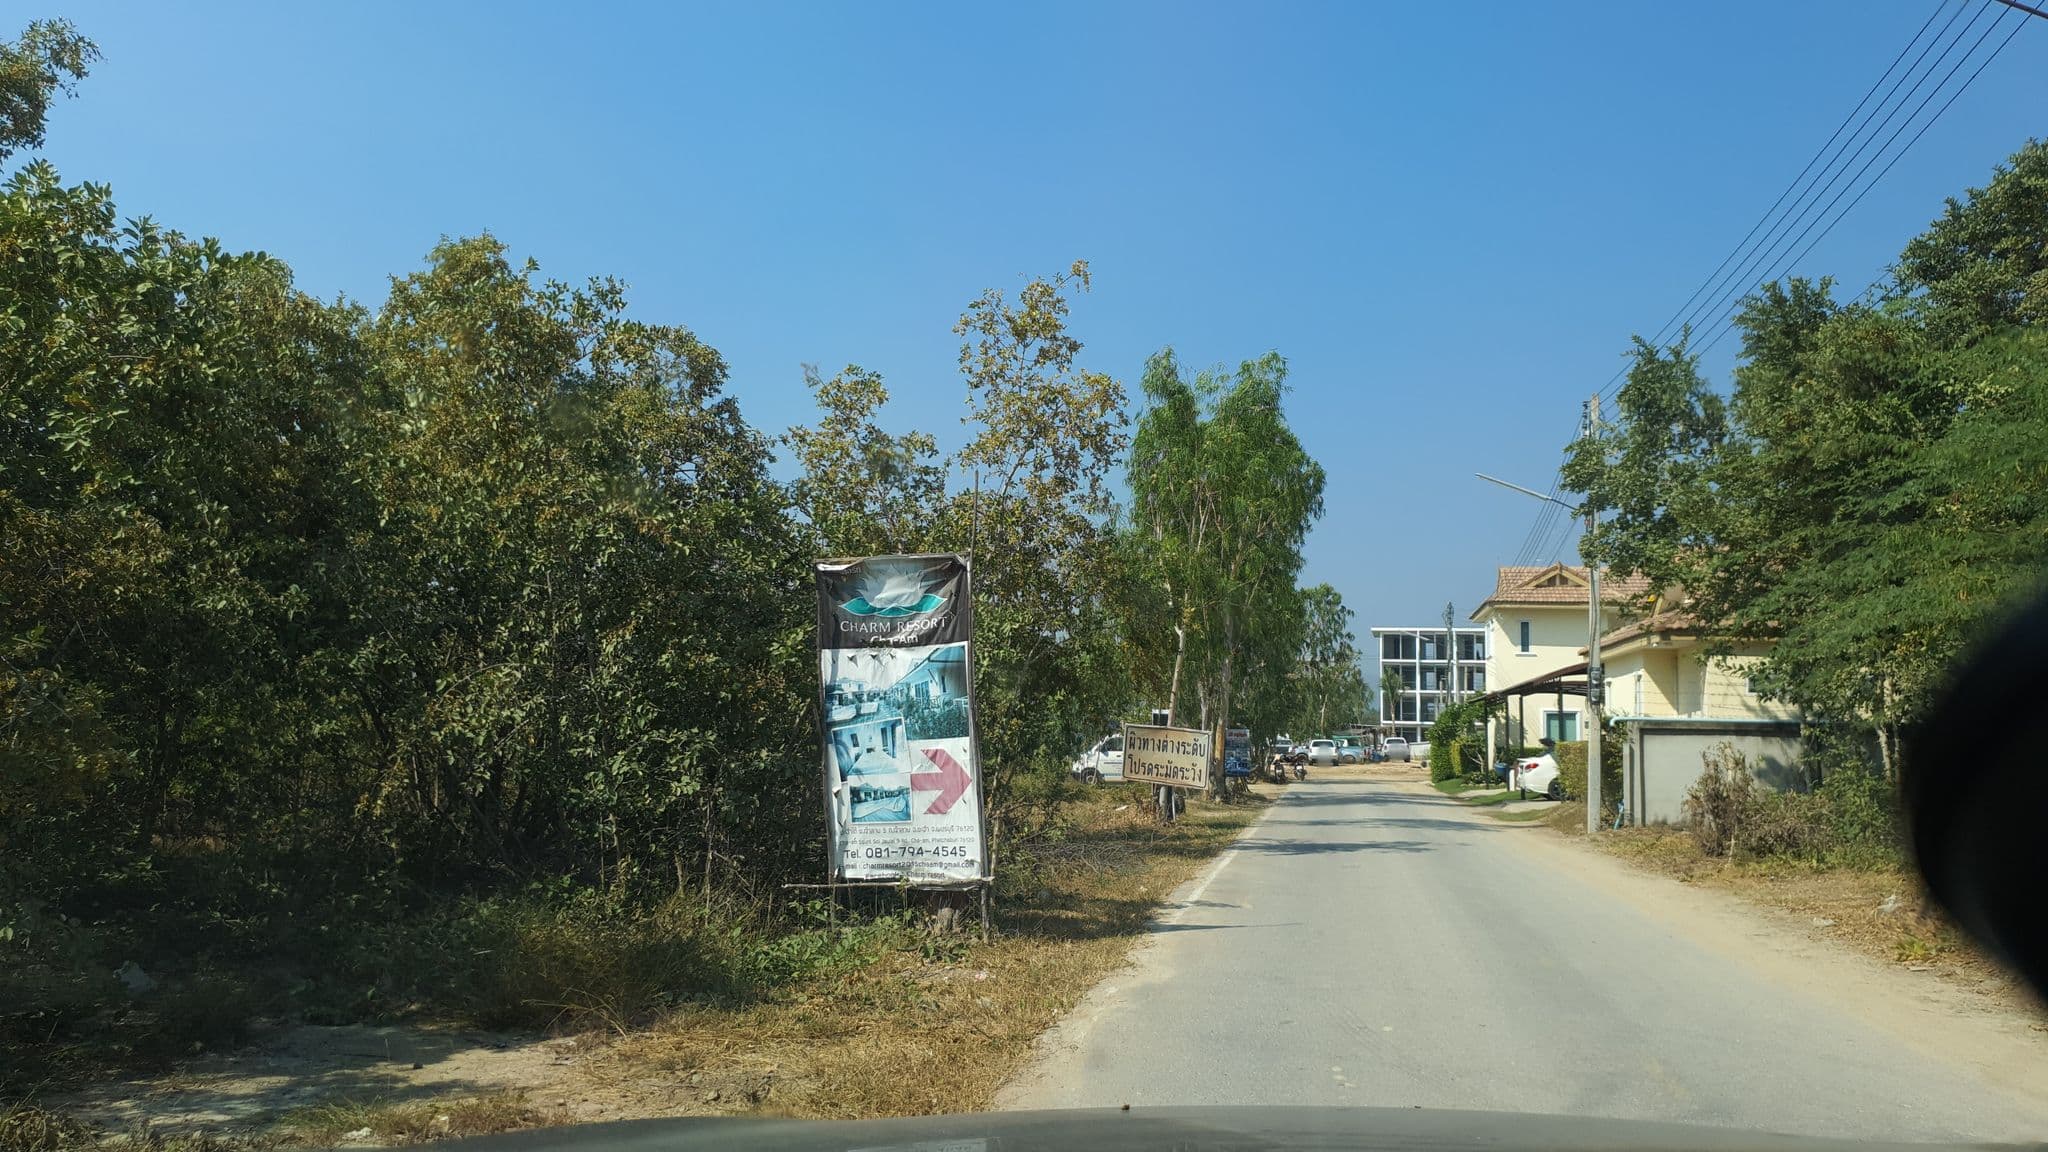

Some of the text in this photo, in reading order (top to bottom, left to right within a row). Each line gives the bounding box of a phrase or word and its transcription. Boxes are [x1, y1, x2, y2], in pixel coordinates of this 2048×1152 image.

[840, 616, 947, 633] CHARM RESORT
[1128, 731, 1206, 757] ผิวทางต่างระดับ
[1127, 754, 1202, 782] โปรดระมัดระวัง
[844, 845, 967, 859] Tel. 081-794-4545
